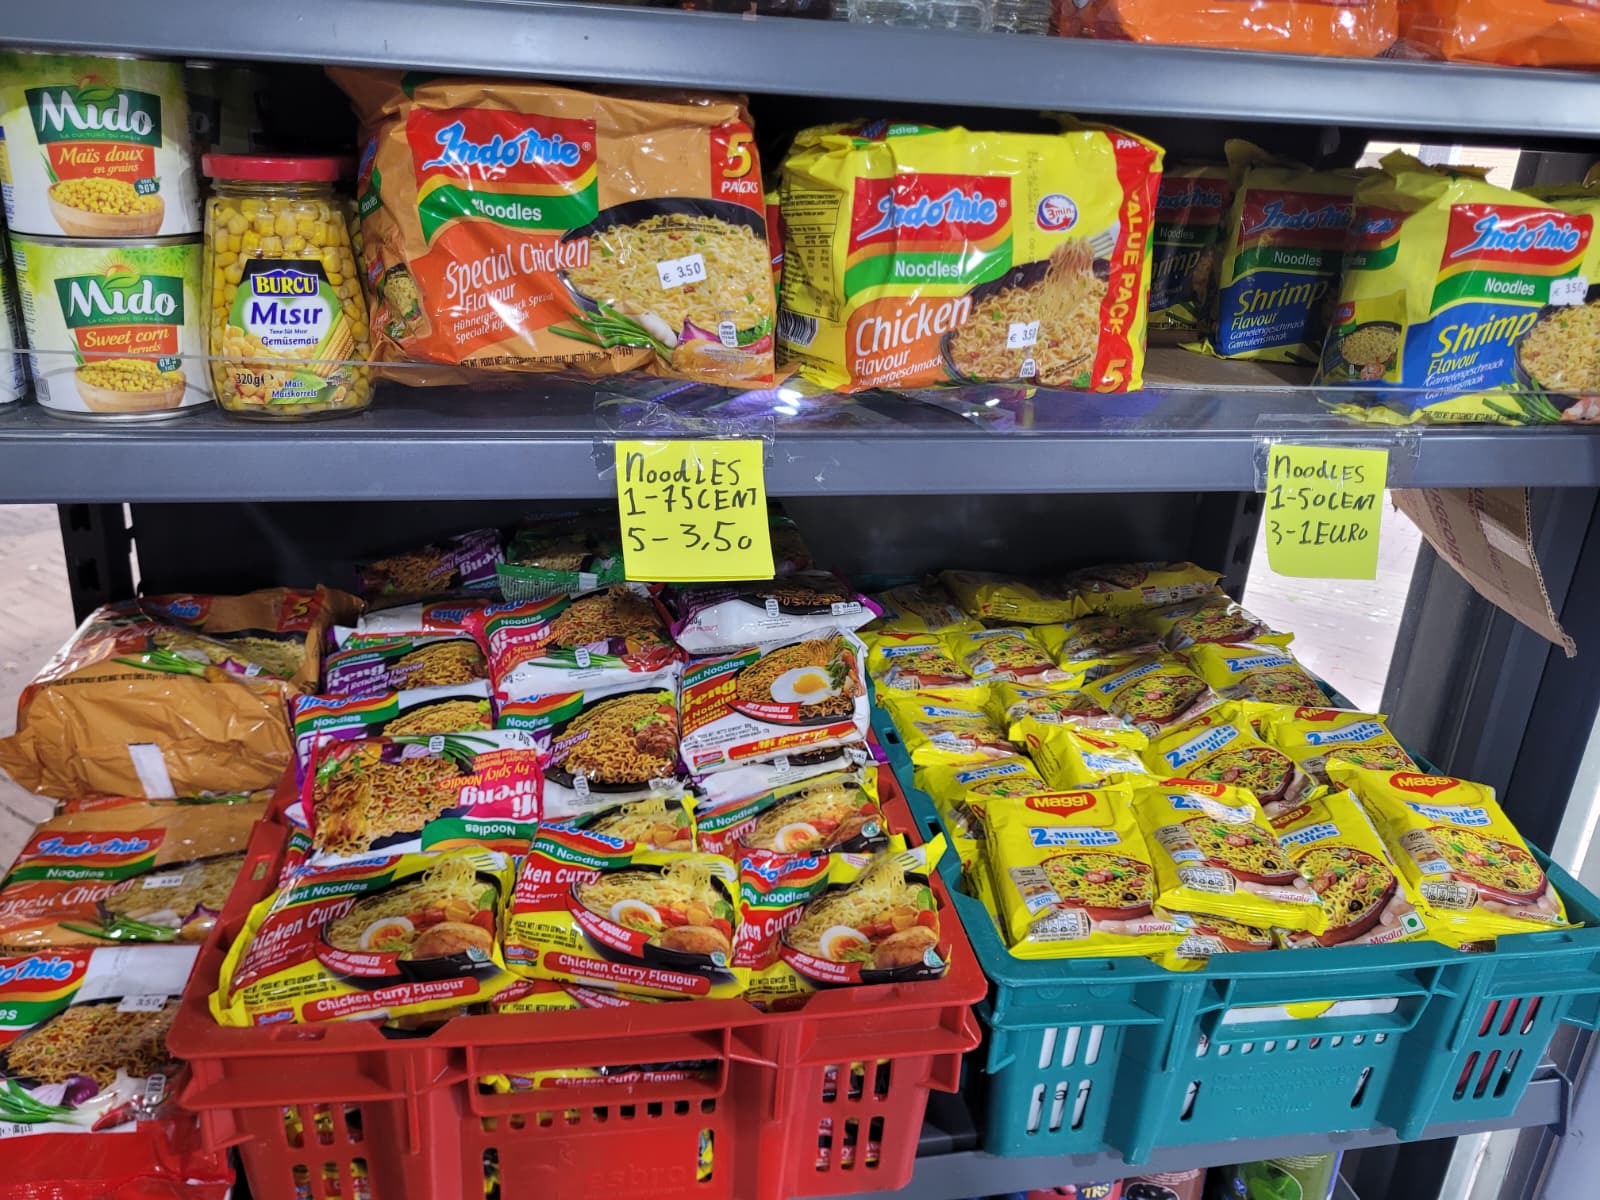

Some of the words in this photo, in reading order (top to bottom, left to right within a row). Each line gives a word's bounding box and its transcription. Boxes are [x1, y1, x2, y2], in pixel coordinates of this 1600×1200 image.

[40, 90, 155, 136] Mido
[58, 146, 100, 166] Maïs
[105, 145, 145, 162] doux
[722, 134, 753, 178] 5
[107, 163, 139, 177] grains
[721, 180, 759, 194] PACKS
[472, 199, 542, 221] Noodles
[1159, 227, 1195, 241] Noodles
[1152, 250, 1201, 280] hrimp
[1274, 251, 1323, 267] Noodles
[446, 244, 517, 306] Special
[520, 239, 589, 274] Chicken
[895, 259, 961, 279] Noodles
[256, 276, 315, 295] BURCU
[1484, 277, 1536, 296] Noodles
[70, 279, 178, 317] Mido
[465, 283, 516, 312] Flavour
[1109, 272, 1137, 337] PACK
[1233, 280, 1329, 317] Shrimp
[454, 298, 526, 332] Hühnergesack
[1231, 312, 1279, 331] Flavour
[855, 295, 972, 357] Chicken
[1431, 312, 1538, 358] Shrimp
[84, 330, 132, 347] Sweet
[136, 328, 169, 343] corn
[261, 336, 318, 347] Gemüsemais
[127, 341, 161, 354] kernels
[855, 348, 910, 376] Flavour
[1427, 351, 1480, 376] Flavour
[1095, 358, 1128, 394] 5
[289, 598, 310, 619] 5
[500, 615, 542, 626] Noodles
[512, 644, 535, 655] Spicy
[390, 662, 425, 678] Flavour
[703, 659, 746, 677] Noodles
[692, 692, 738, 718] Noodles
[313, 714, 362, 728] Noodles
[506, 716, 550, 729] Noodles
[554, 728, 592, 753] Flavour
[1306, 722, 1381, 746] 2-Minute
[1166, 724, 1233, 769] 2-Minute
[485, 765, 513, 783] Spicy
[514, 763, 530, 778] Fry
[439, 773, 483, 791] Noodles
[1397, 776, 1453, 787] Maggi
[1033, 795, 1088, 809] Maggi
[716, 805, 759, 827] Noodles
[464, 823, 517, 837] Noodles
[725, 818, 759, 844] Curry
[1030, 827, 1115, 846] 2-Minute
[1280, 824, 1334, 848] Minute
[557, 848, 609, 867] Noodles
[46, 867, 105, 879] Noodles
[555, 867, 601, 885] Curry
[61, 878, 136, 906] Chicken
[312, 881, 369, 897] Noodles
[760, 890, 810, 903] Noodles
[307, 898, 356, 928] Curry
[765, 905, 805, 939] Curry
[599, 920, 632, 943] NOODLES
[1137, 923, 1172, 932] Masala
[1370, 928, 1404, 944] Masala
[349, 953, 381, 966] NOODLES
[795, 952, 813, 966] SOUP
[814, 958, 846, 974] NOODLES
[558, 954, 608, 973] Chicken
[611, 963, 647, 980] Curry
[649, 970, 699, 988] Flavour
[317, 994, 371, 1013] Chicken
[373, 986, 411, 1001] Curry
[413, 979, 466, 994] Flavour
[1081, 1184, 1111, 1200] TRS
